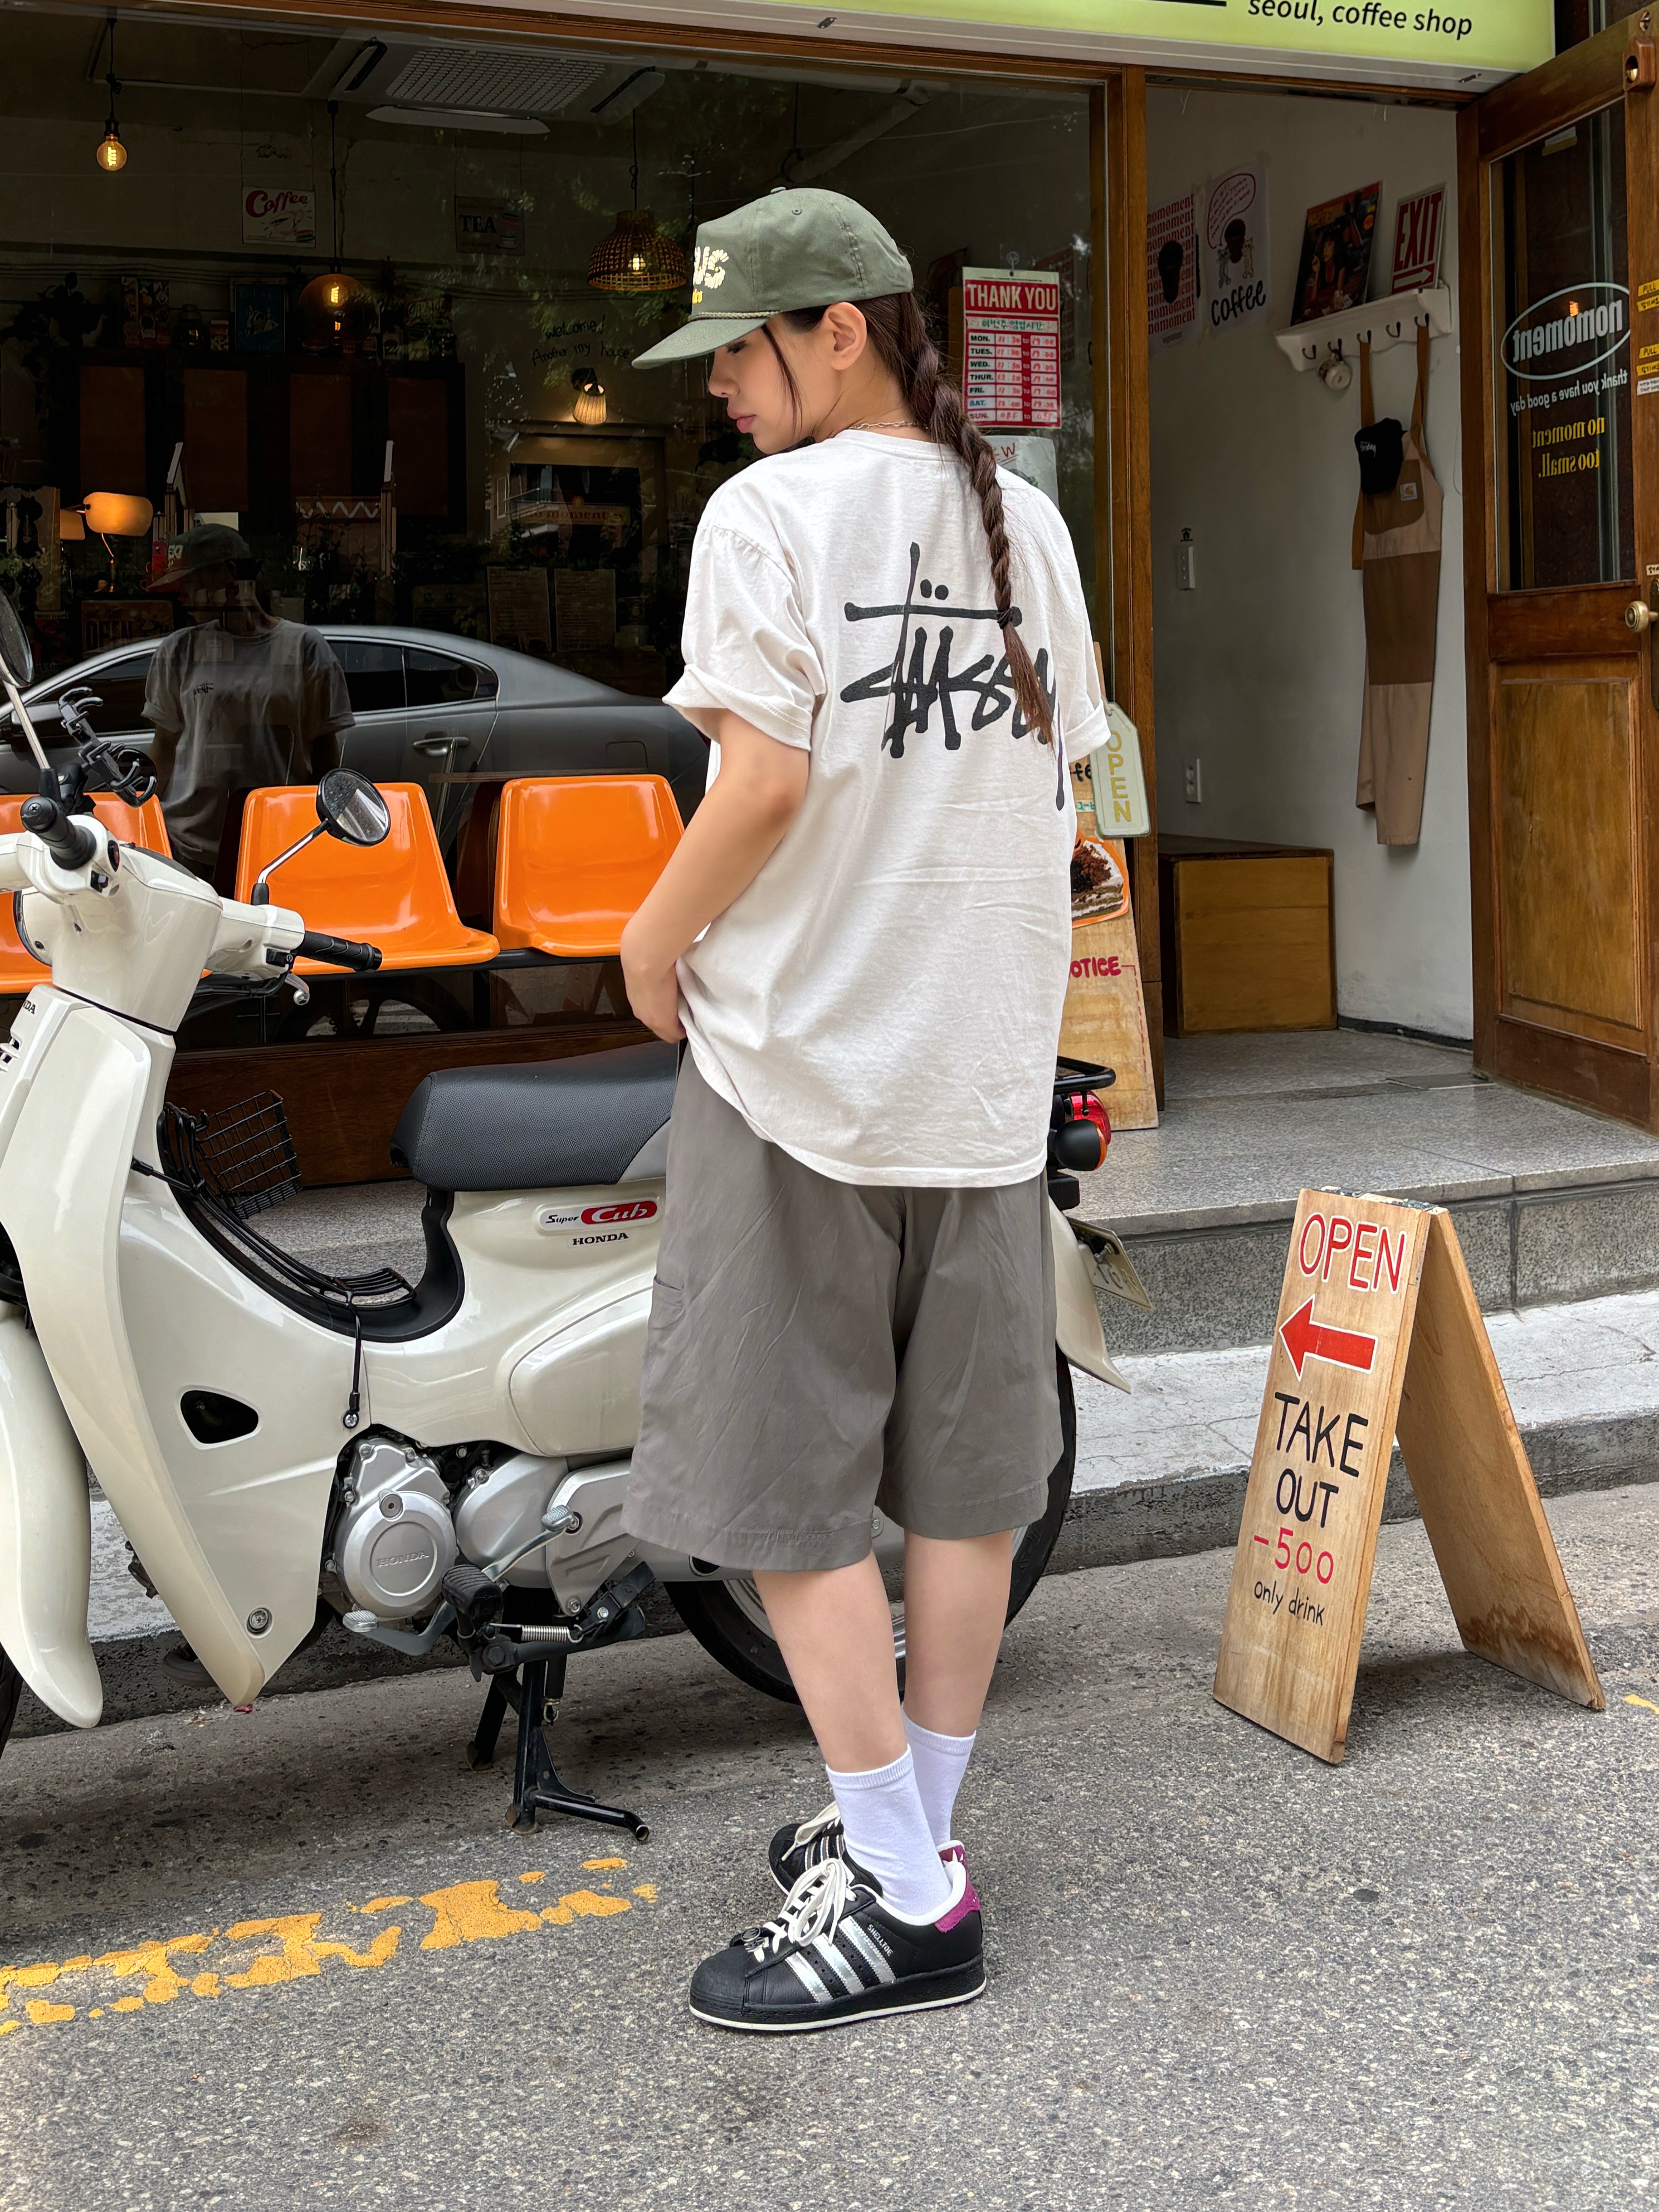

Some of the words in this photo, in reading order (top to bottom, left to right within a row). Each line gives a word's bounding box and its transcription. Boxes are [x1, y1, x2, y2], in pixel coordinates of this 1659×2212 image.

[1247, 0, 1324, 26] seoul,
[1333, 2, 1407, 29] coffee
[1413, 8, 1473, 41] shop
[245, 190, 308, 218] Coffee
[460, 215, 497, 233] TEA
[1393, 191, 1442, 273] EXIT
[967, 284, 1022, 309] THANK
[1024, 286, 1056, 311] YOU
[1212, 280, 1266, 326] coffee
[1148, 307, 1194, 335] nomoment
[574, 342, 590, 357] my
[600, 340, 630, 359] house
[1643, 346, 1657, 356] PULL
[1105, 730, 1132, 822] OPEN
[1070, 956, 1121, 978] OTICE
[545, 1214, 579, 1224] Super
[591, 1204, 648, 1223] Cub
[572, 1233, 629, 1246] HONDA
[1299, 1213, 1407, 1294] OPEN
[1275, 1391, 1368, 1478] TAKE
[1276, 1468, 1339, 1529] OUT
[377, 1551, 430, 1568] HONDA
[1253, 1527, 1334, 1584] -500
[1254, 1580, 1284, 1615] only
[1288, 1587, 1325, 1627] drink
[867, 1924, 894, 1957] SHELLTOE
